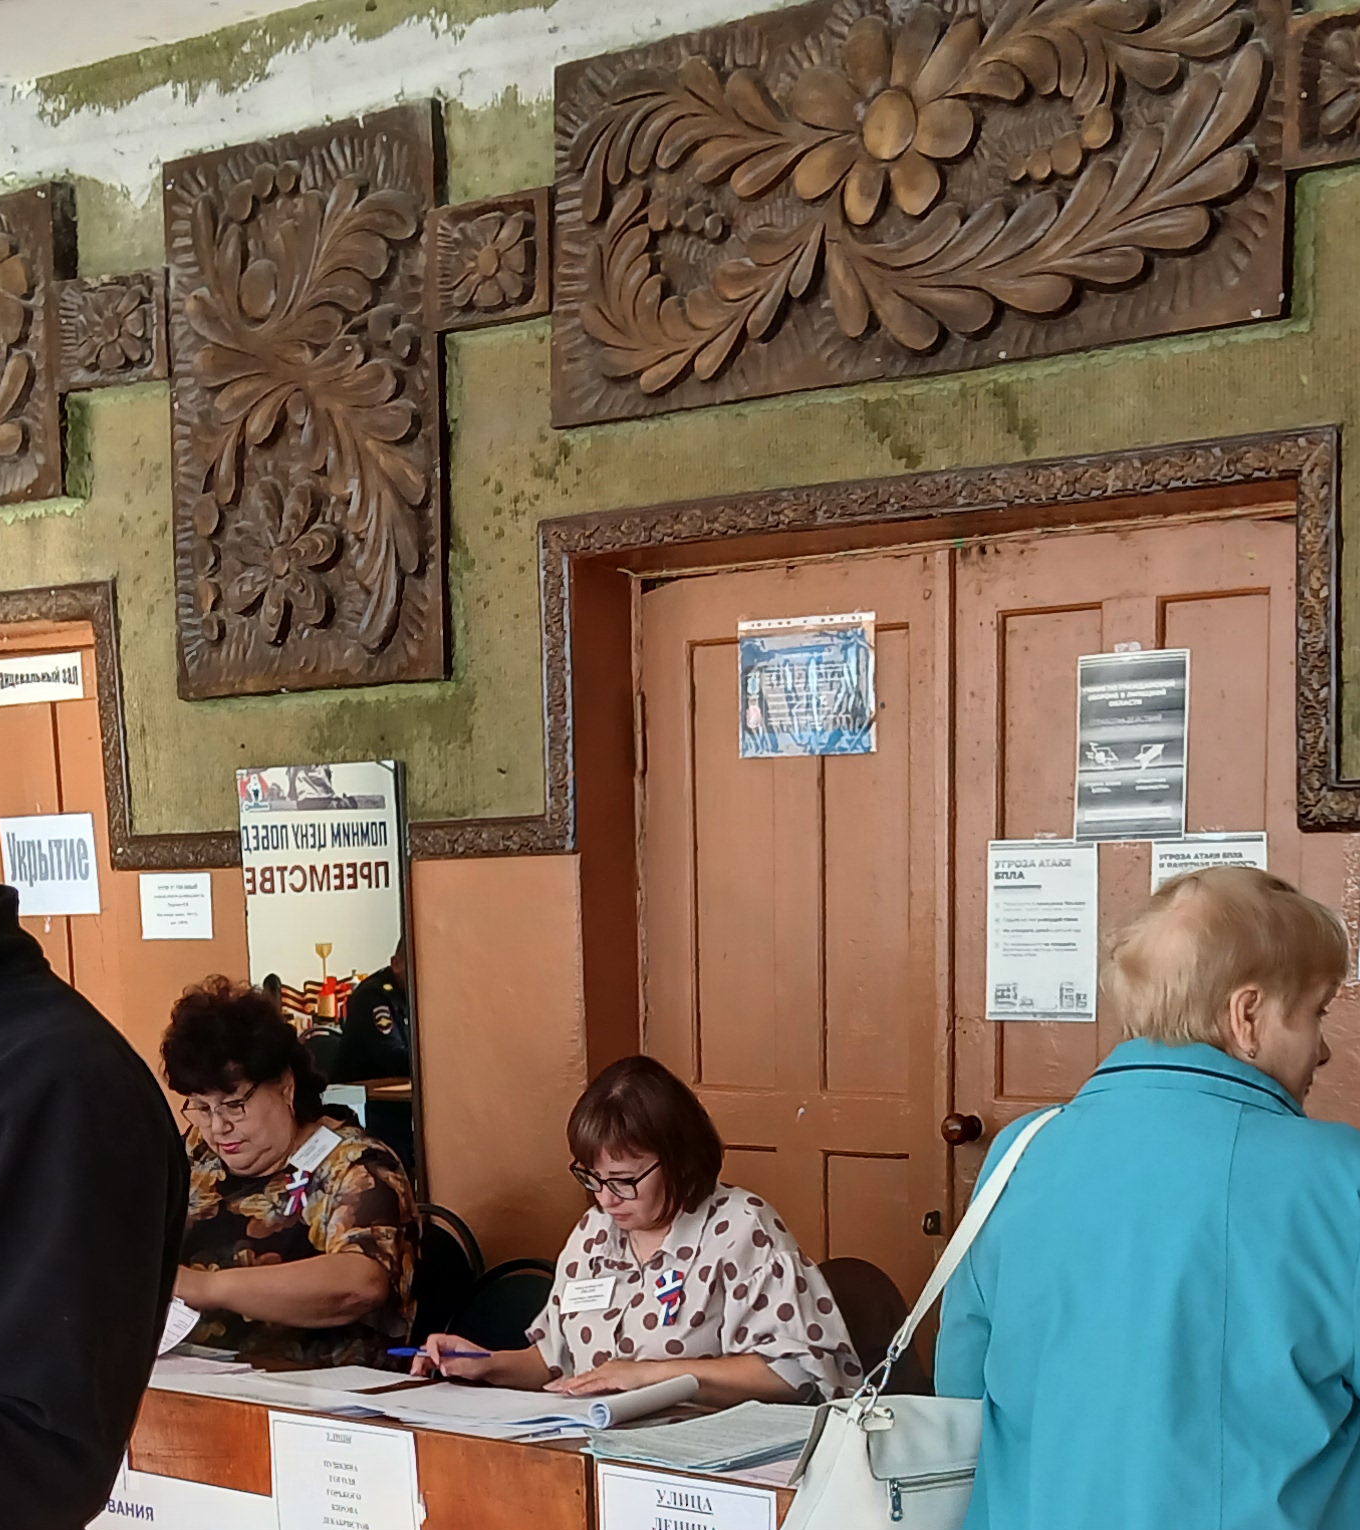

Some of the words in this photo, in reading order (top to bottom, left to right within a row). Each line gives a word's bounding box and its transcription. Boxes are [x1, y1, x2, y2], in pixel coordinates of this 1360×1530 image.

[6, 832, 89, 887] Укрытие
[994, 860, 1036, 869] УГРОЗА
[656, 1489, 713, 1511] УЛИЦА
